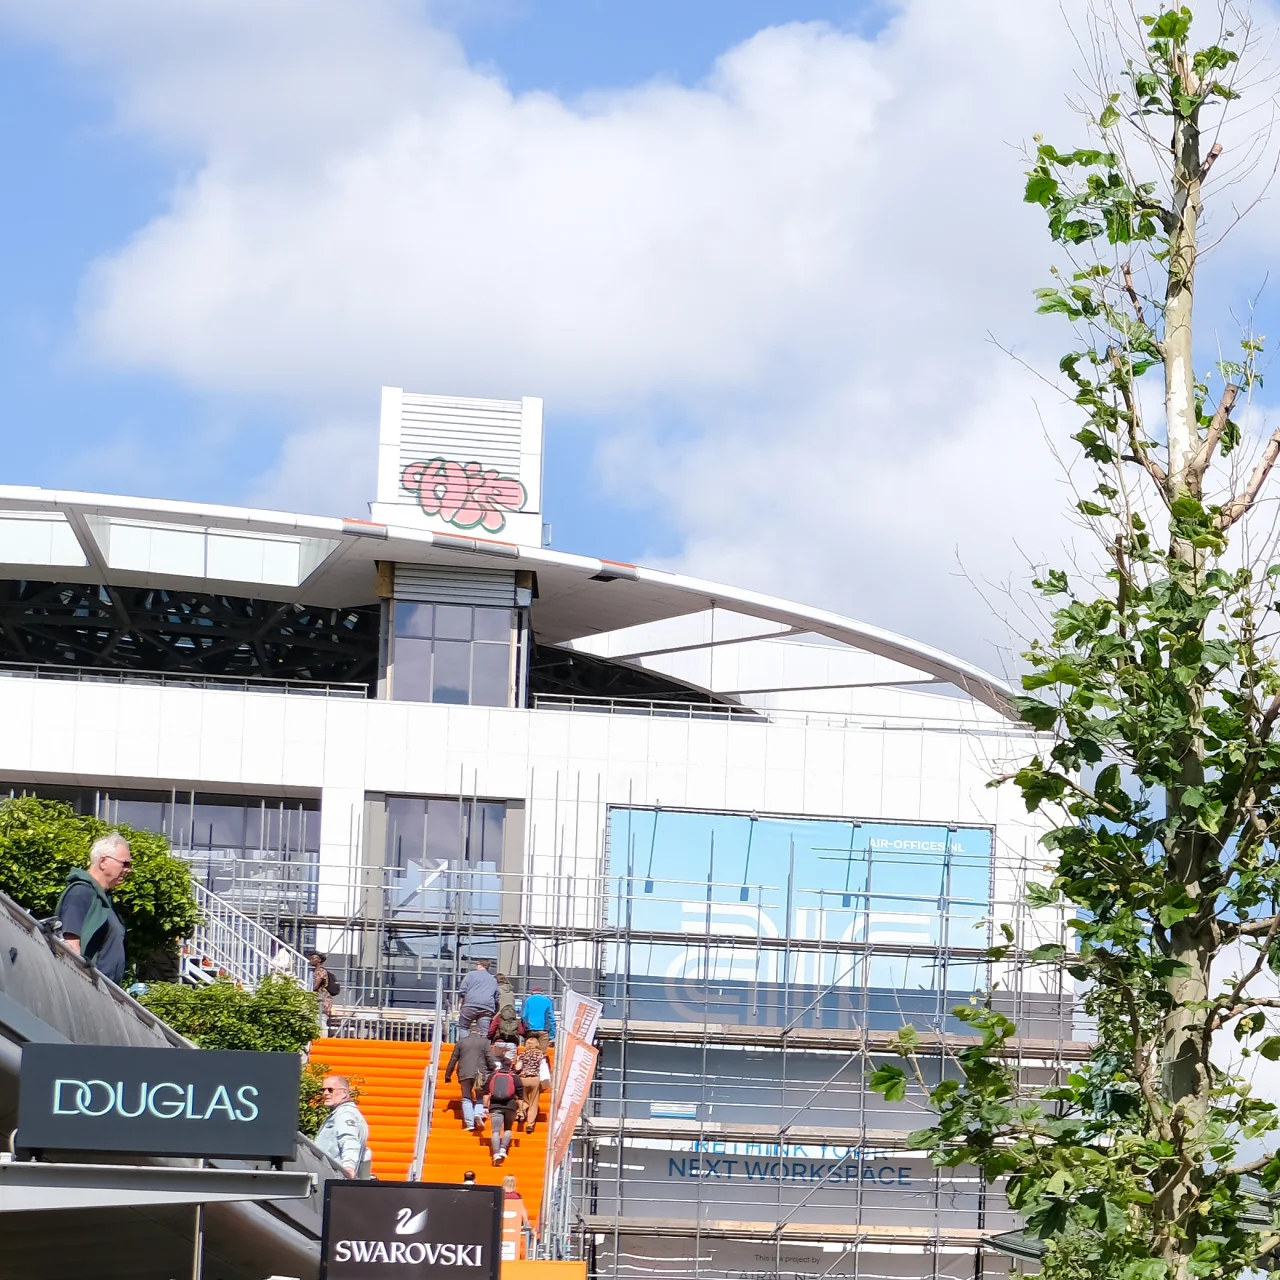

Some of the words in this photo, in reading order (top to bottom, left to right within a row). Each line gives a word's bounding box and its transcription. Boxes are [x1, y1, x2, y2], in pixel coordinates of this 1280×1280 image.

[870, 837, 965, 853] AIR-OFFICESNL
[53, 1078, 259, 1122] DOUGLAS
[668, 1157, 739, 1180] NEXT
[744, 1160, 913, 1186] WORKSPACE
[334, 1240, 484, 1267] SWAROVSKI
